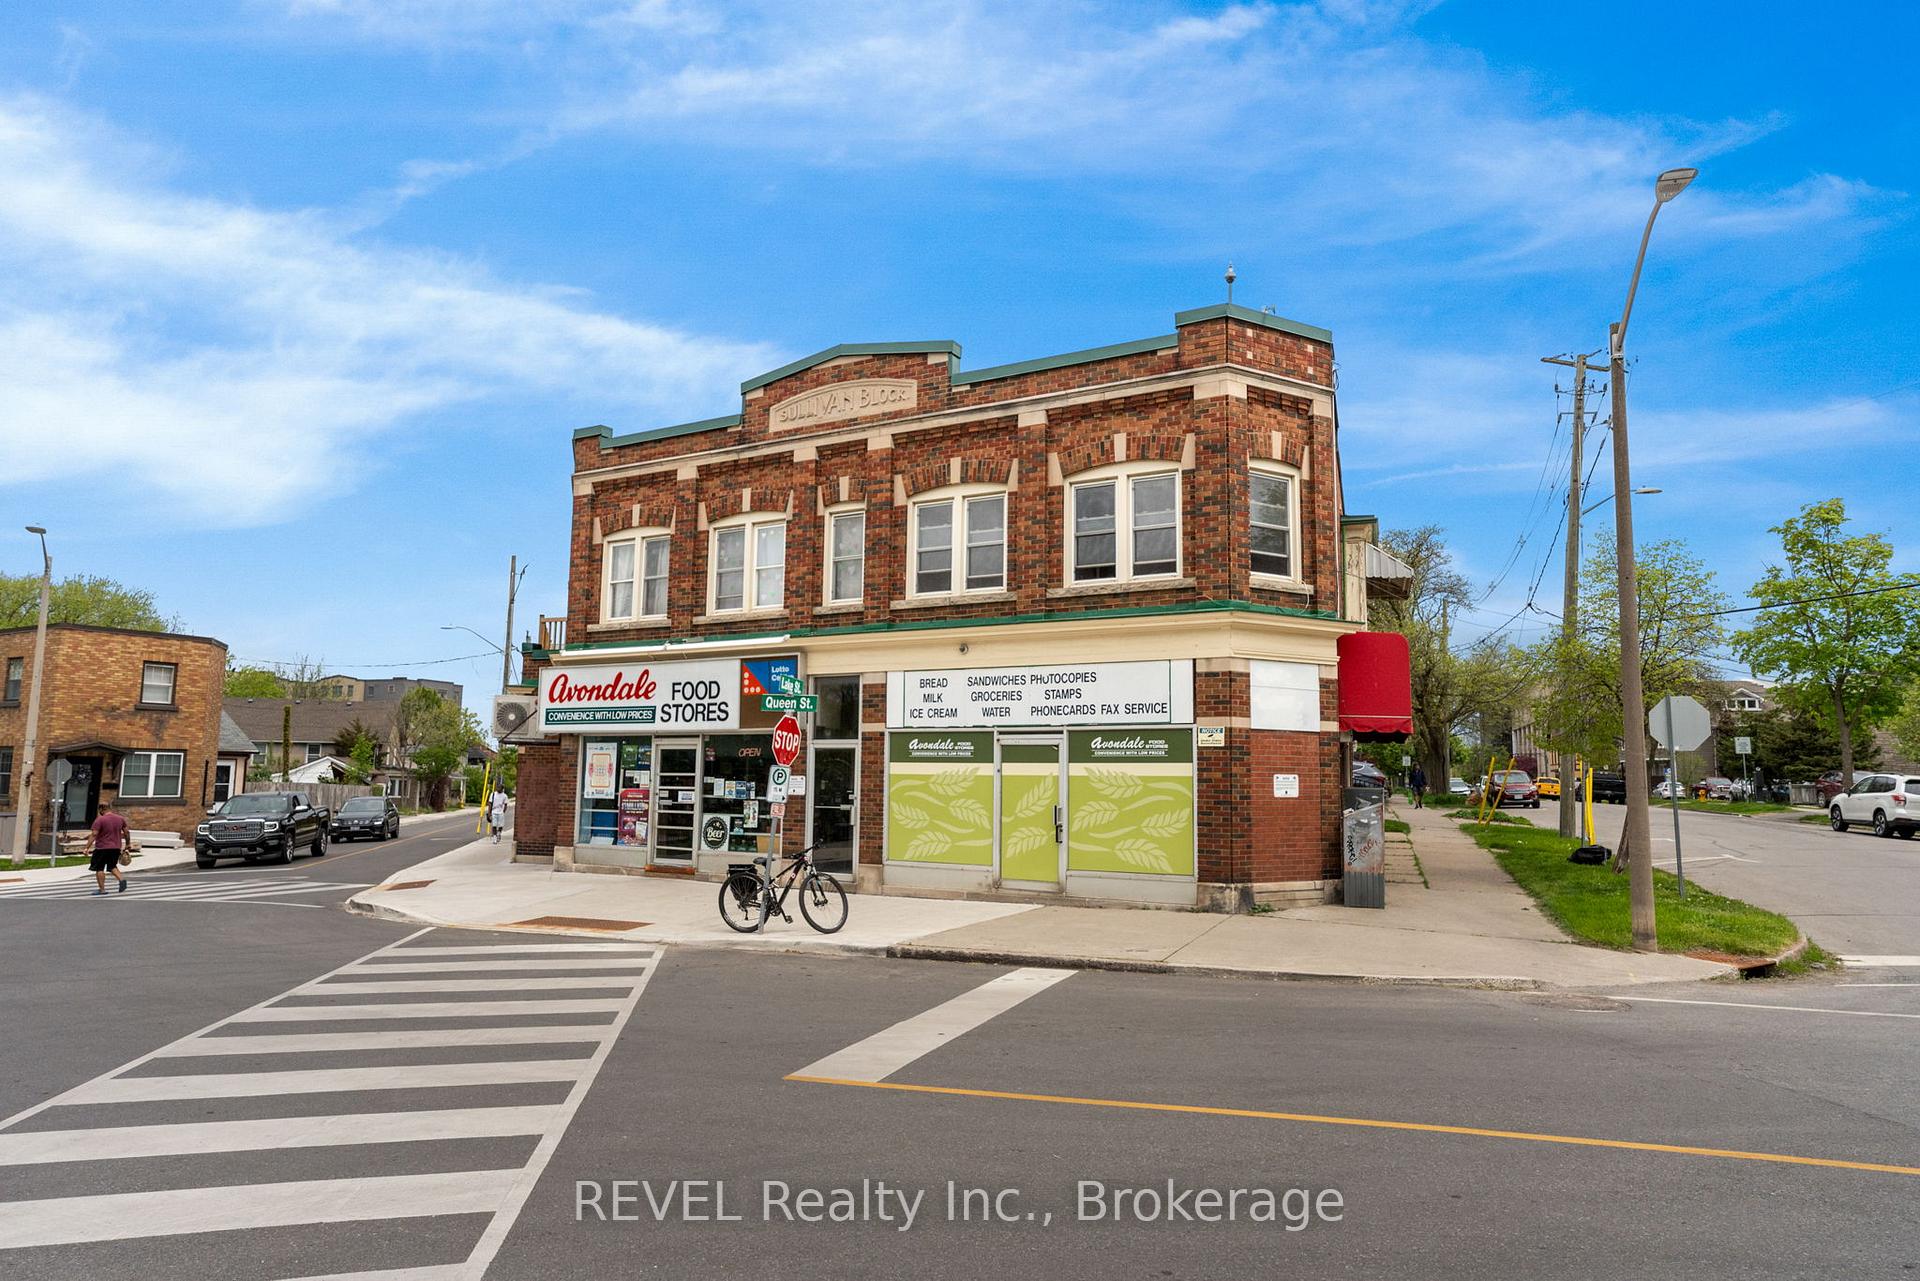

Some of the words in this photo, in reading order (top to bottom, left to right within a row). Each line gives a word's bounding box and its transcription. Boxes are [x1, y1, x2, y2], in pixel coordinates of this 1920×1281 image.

[771, 665, 790, 673] Lotto
[781, 677, 794, 690] Lake
[919, 678, 948, 688] BREAD
[967, 675, 1027, 687] SANDWICHES
[1030, 672, 1097, 684] PHOTOCOPIES
[548, 669, 657, 703] Avondale
[671, 680, 721, 701] FOOD
[923, 693, 943, 703] MILK
[970, 690, 1023, 701] GROCERIES
[1044, 688, 1082, 700] STAMPS
[765, 696, 797, 709] Queen
[799, 697, 813, 709] St.
[1100, 703, 1120, 714] FAX
[1124, 702, 1168, 714] SERVICE
[548, 711, 594, 721] CONVENIENCE
[594, 711, 612, 720] WITH
[612, 711, 627, 719] LOW
[627, 710, 653, 719] PRICES
[660, 702, 729, 723] STORES
[909, 708, 924, 718] ICE
[927, 708, 958, 718] CREAM
[982, 707, 1011, 717] WATER
[1030, 704, 1096, 716] PHONECARDS
[774, 730, 799, 752] STOP
[908, 738, 955, 750] Avondale
[1090, 736, 1145, 749] Avondale
[738, 747, 761, 757] OPEN
[776, 771, 784, 781] P
